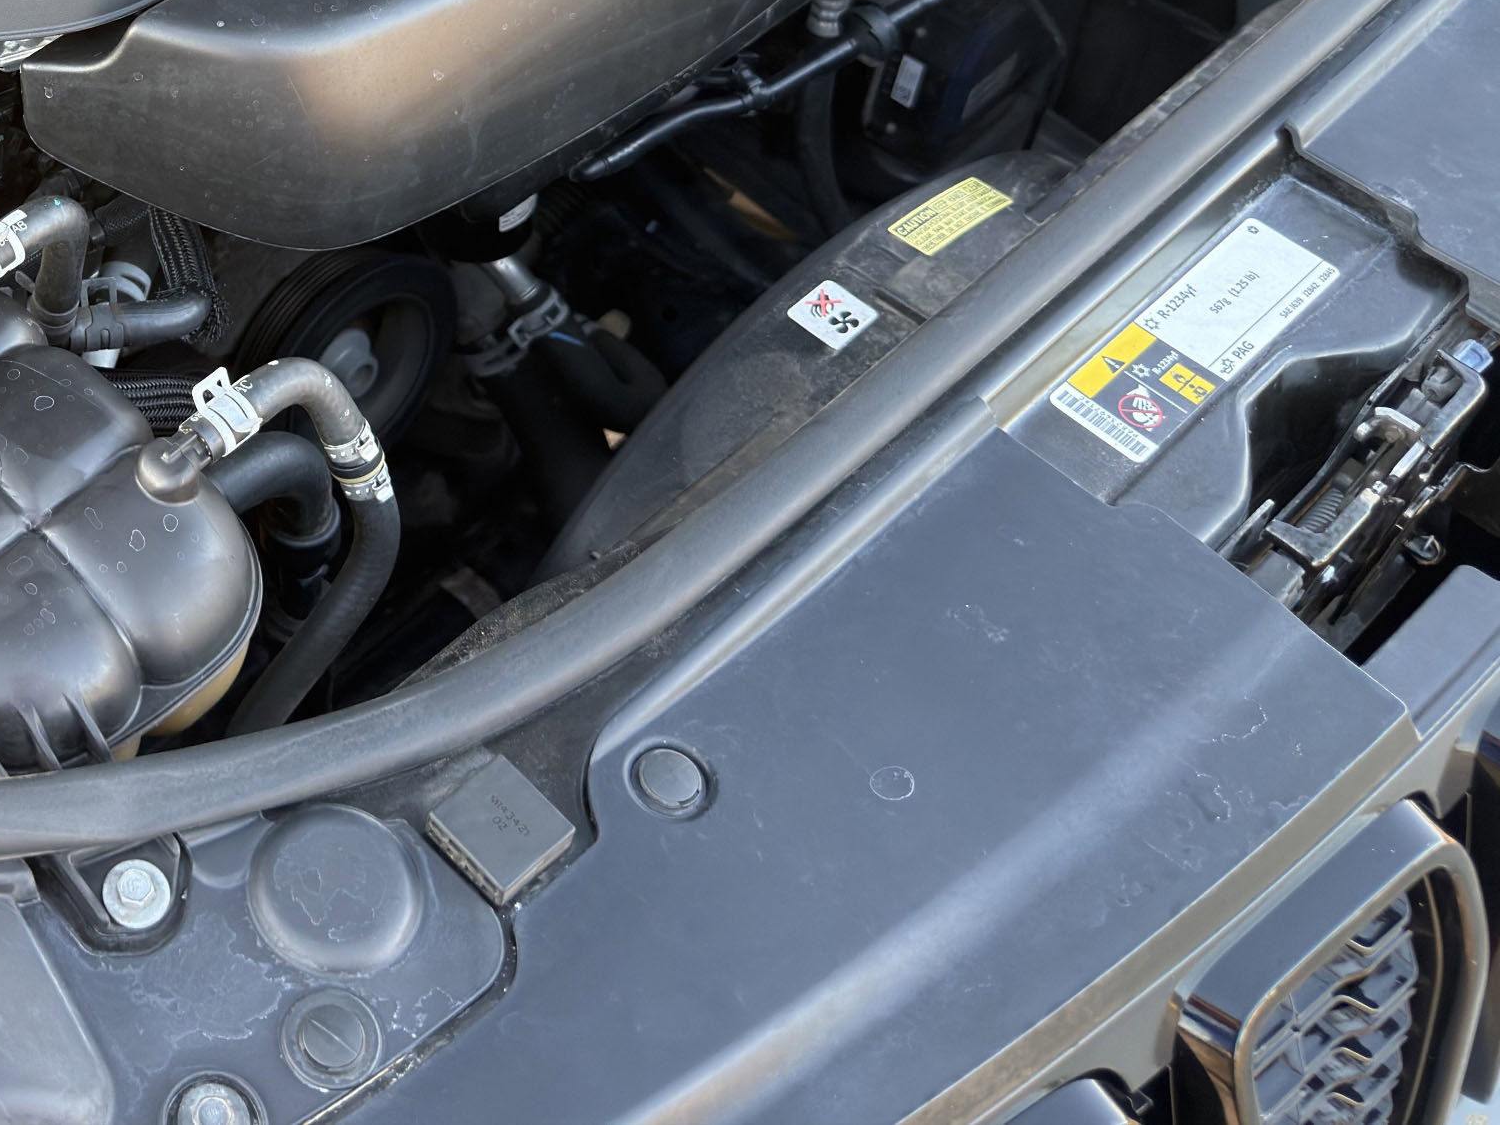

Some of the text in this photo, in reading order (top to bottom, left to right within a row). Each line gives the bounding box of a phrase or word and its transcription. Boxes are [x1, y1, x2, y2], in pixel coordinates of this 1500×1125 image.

[896, 207, 937, 237] CAUTION
[1157, 283, 1198, 320] R-1234yf
[1209, 297, 1233, 315] 567g
[1227, 278, 1250, 298] (1.25
[1231, 340, 1255, 360] PAG
